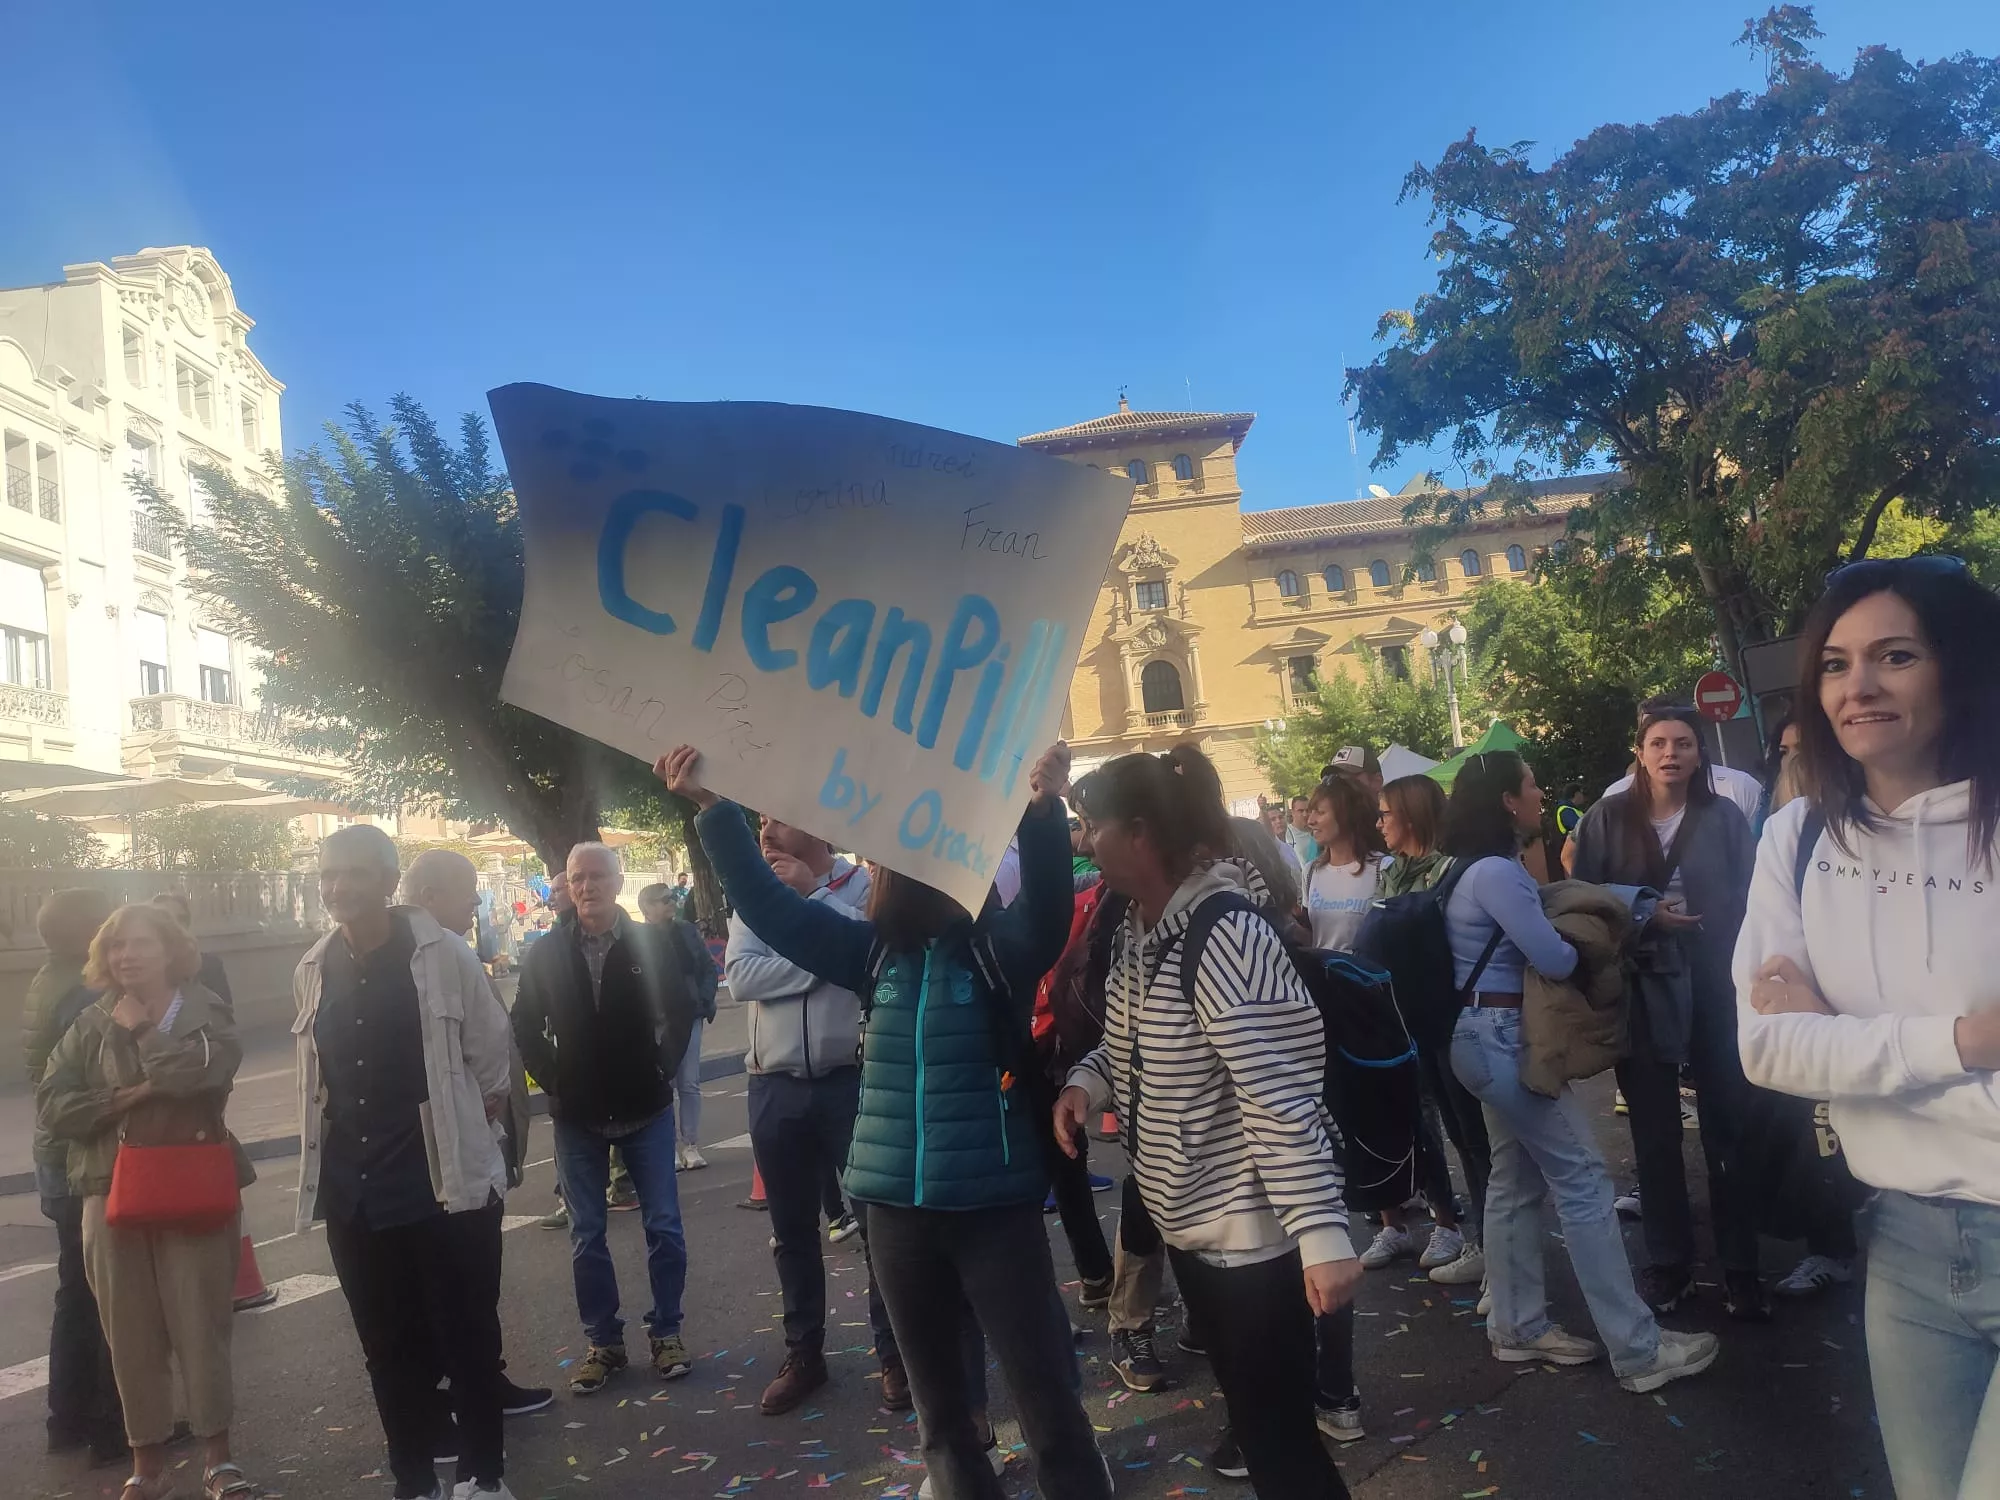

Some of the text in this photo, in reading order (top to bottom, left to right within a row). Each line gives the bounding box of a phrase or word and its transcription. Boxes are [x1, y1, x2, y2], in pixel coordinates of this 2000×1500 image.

[884, 440, 976, 478] ndrei
[960, 503, 1049, 561] Fran
[597, 490, 1067, 800] CleanPill
[818, 746, 882, 827] by
